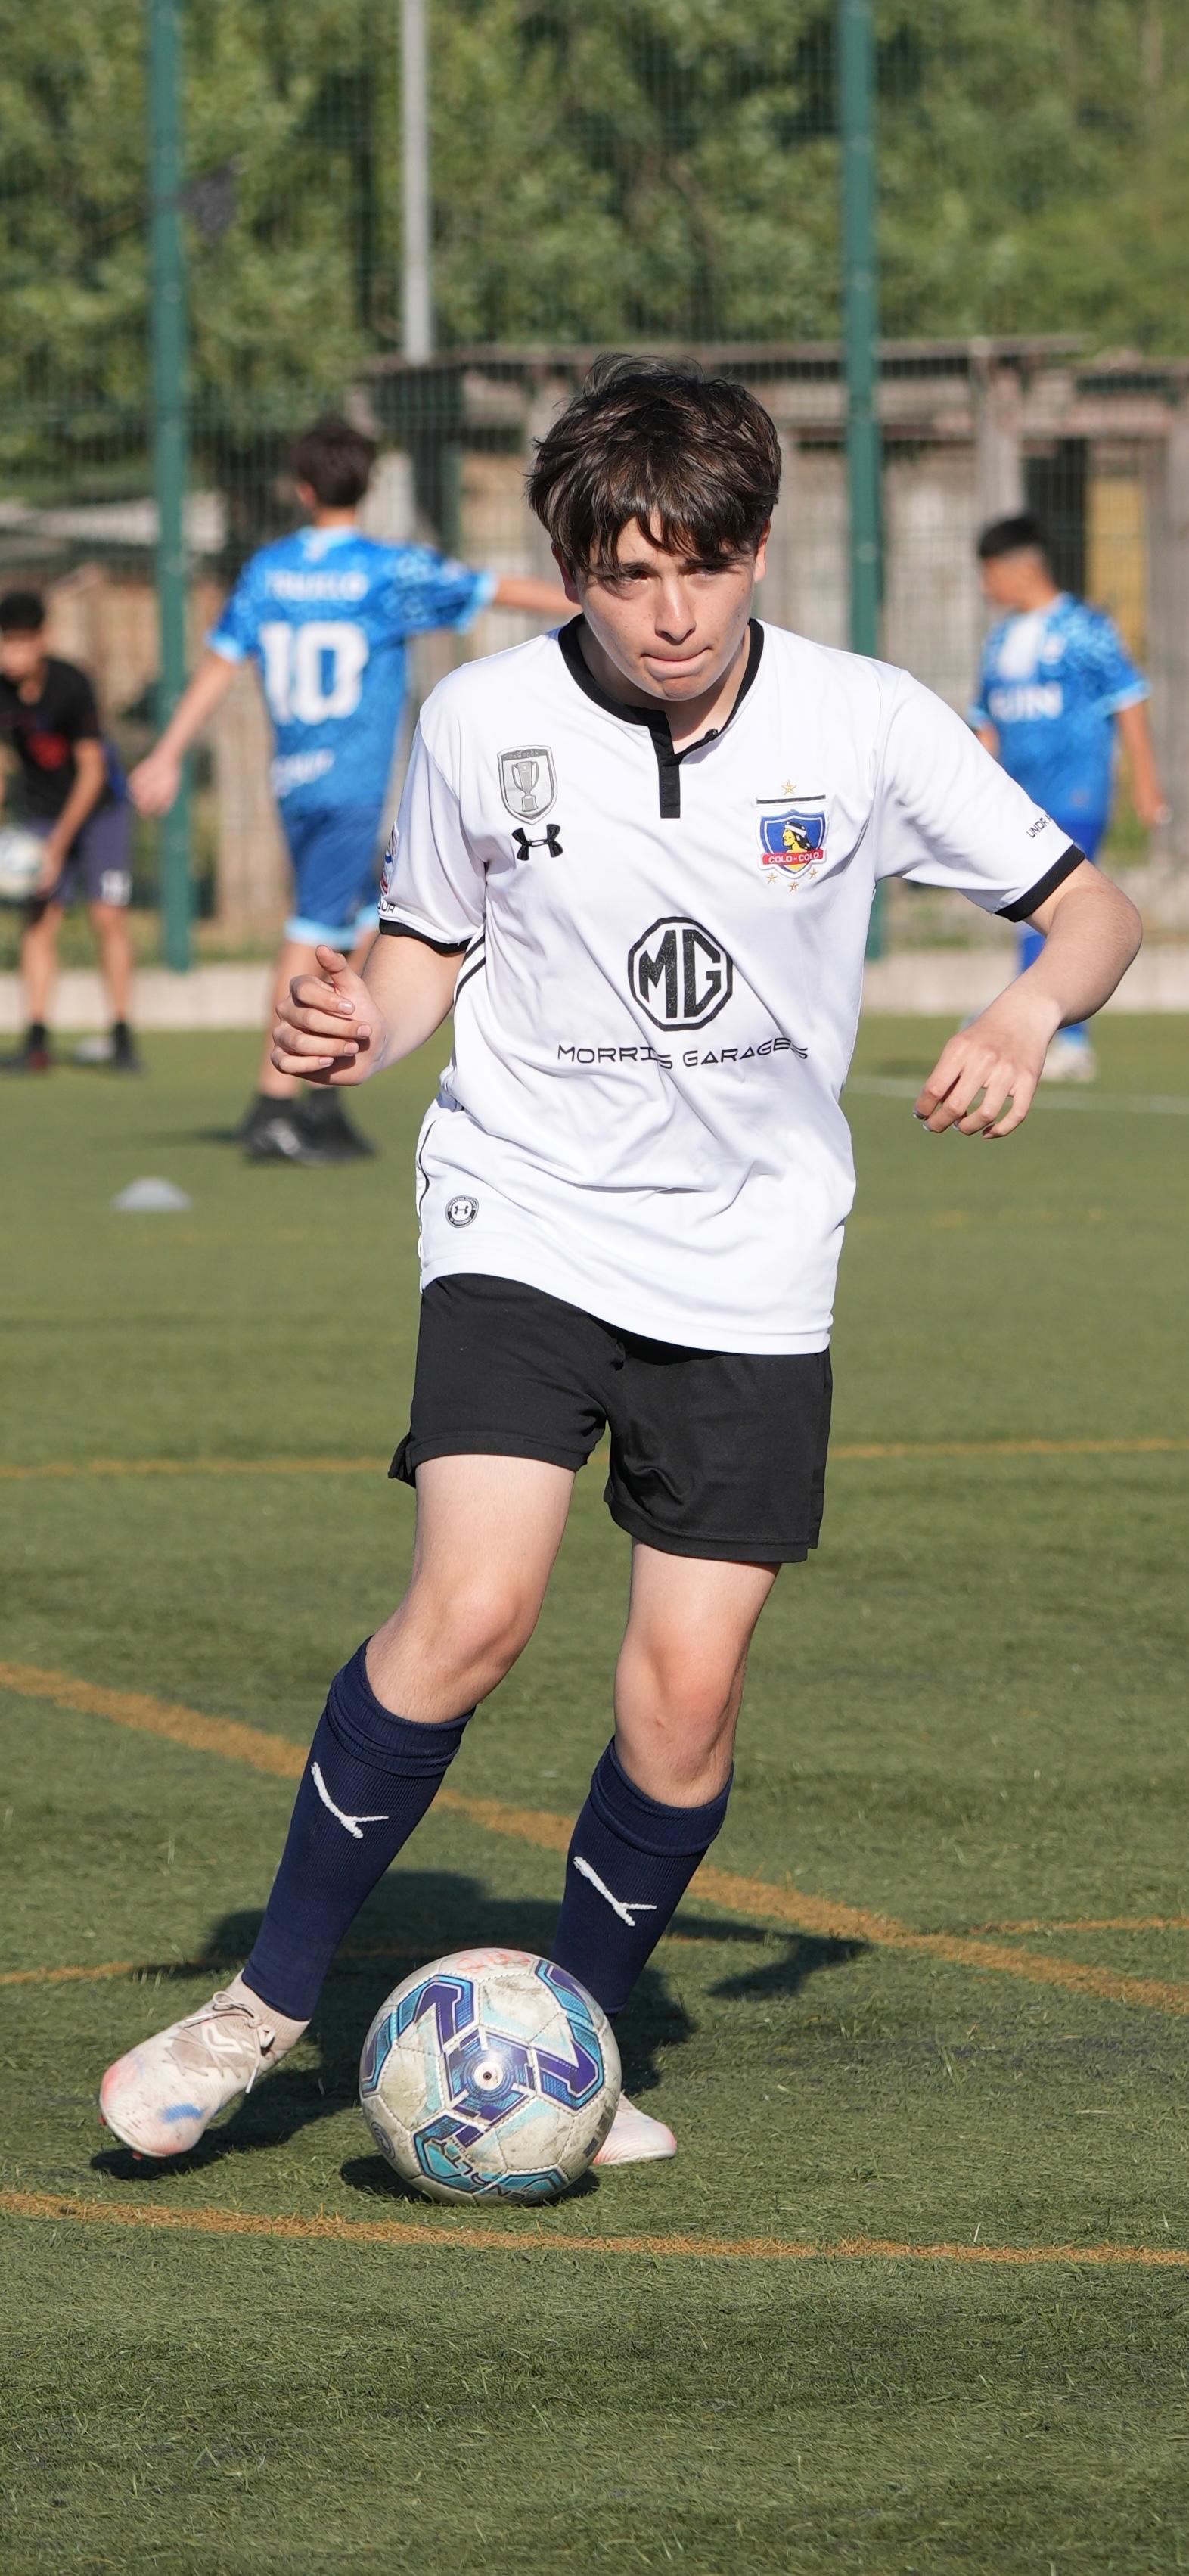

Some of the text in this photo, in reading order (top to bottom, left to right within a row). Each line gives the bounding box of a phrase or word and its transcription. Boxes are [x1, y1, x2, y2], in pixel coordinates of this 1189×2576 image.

[259, 621, 368, 723] 10
[799, 852, 819, 862] COLO
[638, 929, 722, 1018] MG
[557, 1037, 808, 1070] MORRIS GARAGES
